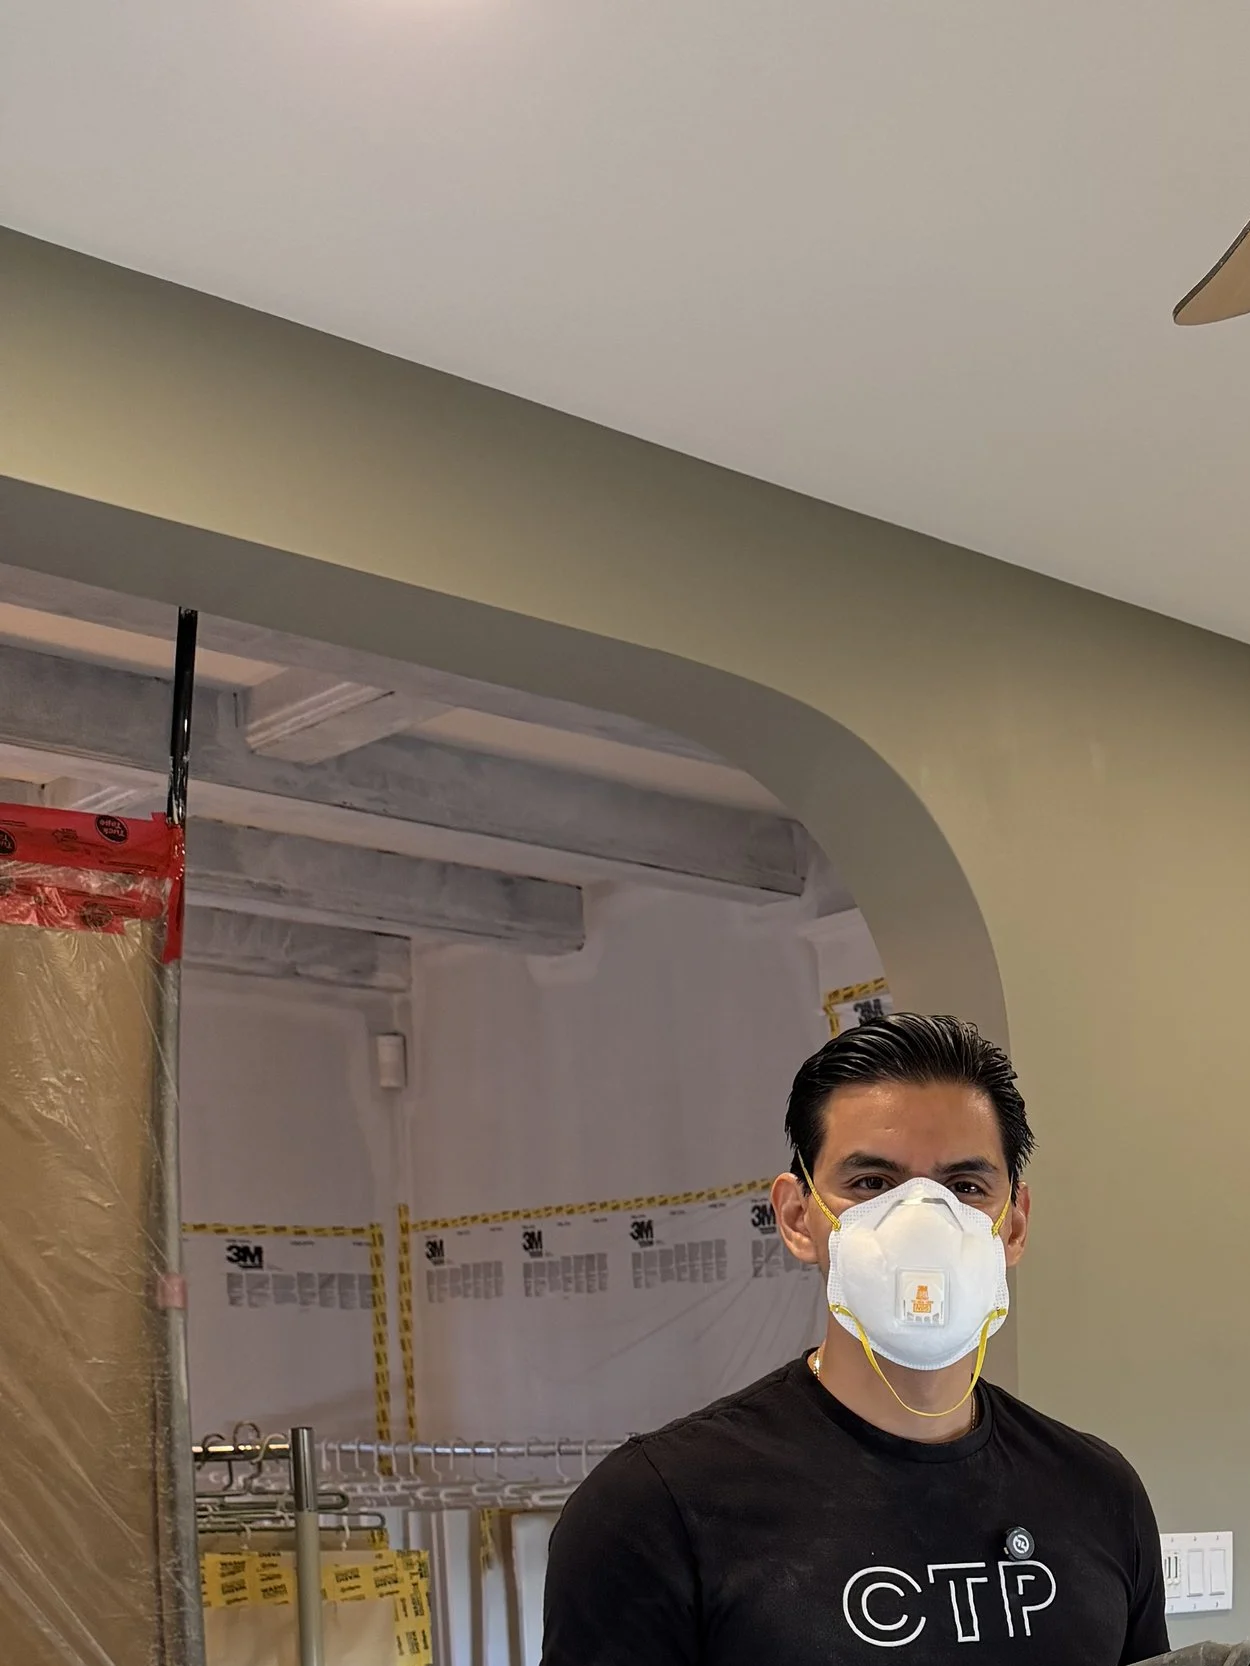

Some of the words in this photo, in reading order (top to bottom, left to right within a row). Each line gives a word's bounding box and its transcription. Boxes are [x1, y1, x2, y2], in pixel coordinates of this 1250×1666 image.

[523, 1230, 543, 1251] 3M
[630, 1219, 654, 1241] 3M
[226, 1245, 263, 1264] 3M
[425, 1239, 445, 1258] 3M
[843, 1560, 1057, 1647] CTP
